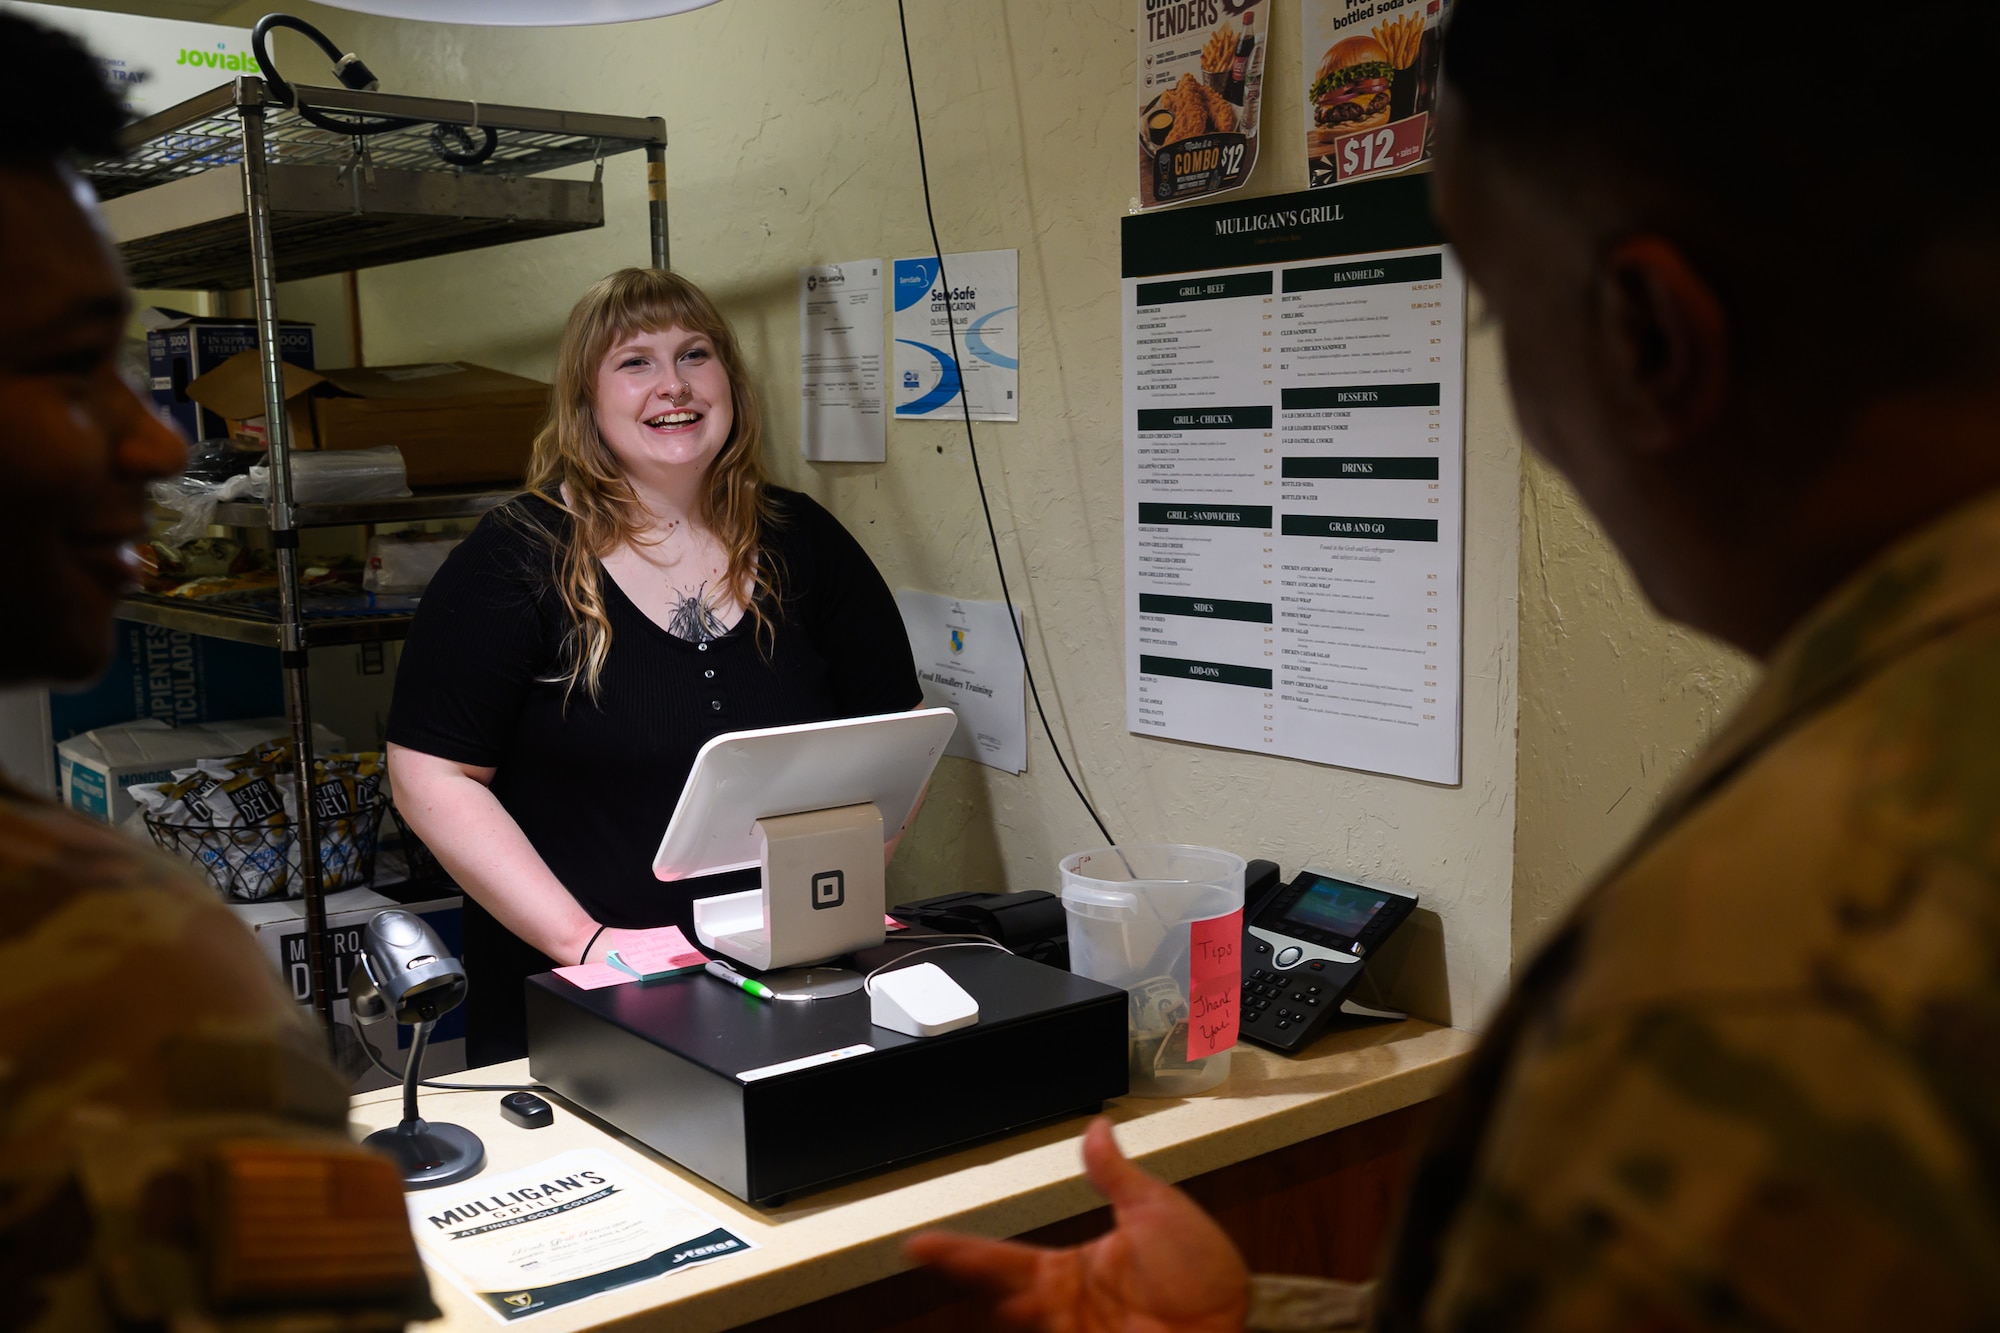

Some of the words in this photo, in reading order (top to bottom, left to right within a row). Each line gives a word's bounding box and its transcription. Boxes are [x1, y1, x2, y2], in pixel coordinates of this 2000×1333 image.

[1146, 0, 1218, 43] TENDERS
[1333, 3, 1374, 30] bottled
[112, 69, 144, 83] TRAY
[1174, 147, 1220, 176] COMBO
[1221, 143, 1244, 175] $12
[1343, 128, 1395, 176] $12
[1215, 210, 1297, 236] MULLIGAN'S
[1300, 204, 1345, 225] GRILL
[1333, 268, 1385, 282] HANDHELDS
[1179, 286, 1203, 297] GRILL
[1206, 284, 1225, 295] BEEF
[931, 302, 976, 312] CERTICATION
[208, 336, 220, 345] IN
[222, 336, 255, 346] SIPPER
[279, 335, 308, 347] 000
[1337, 391, 1378, 402] DESSERTS
[1173, 415, 1196, 425] GRILL
[1199, 414, 1233, 424] CHICKEN
[1341, 463, 1373, 473] DRINKS
[1166, 511, 1189, 520] GRILL
[1193, 512, 1240, 522] SANDWICHES
[1328, 522, 1352, 532] GRAB
[1353, 522, 1371, 533] AND
[1371, 523, 1385, 533] GO
[1192, 602, 1214, 613] SIDES
[1188, 665, 1219, 677] ADD-ONS
[918, 669, 934, 682] Food
[934, 673, 963, 689] Handlers
[965, 681, 993, 698] Training
[231, 780, 269, 807] METRO
[239, 791, 280, 824] DELI
[289, 930, 360, 962] MRO
[1197, 940, 1233, 965] Tips
[1193, 987, 1232, 1018] Thank
[427, 1170, 606, 1230] MULLIGAN'S
[491, 1197, 565, 1220] GRILL
[460, 1229, 478, 1238] AT
[481, 1217, 526, 1232] TINKER
[526, 1208, 562, 1222] GOLF
[562, 1190, 612, 1211] COURSE
